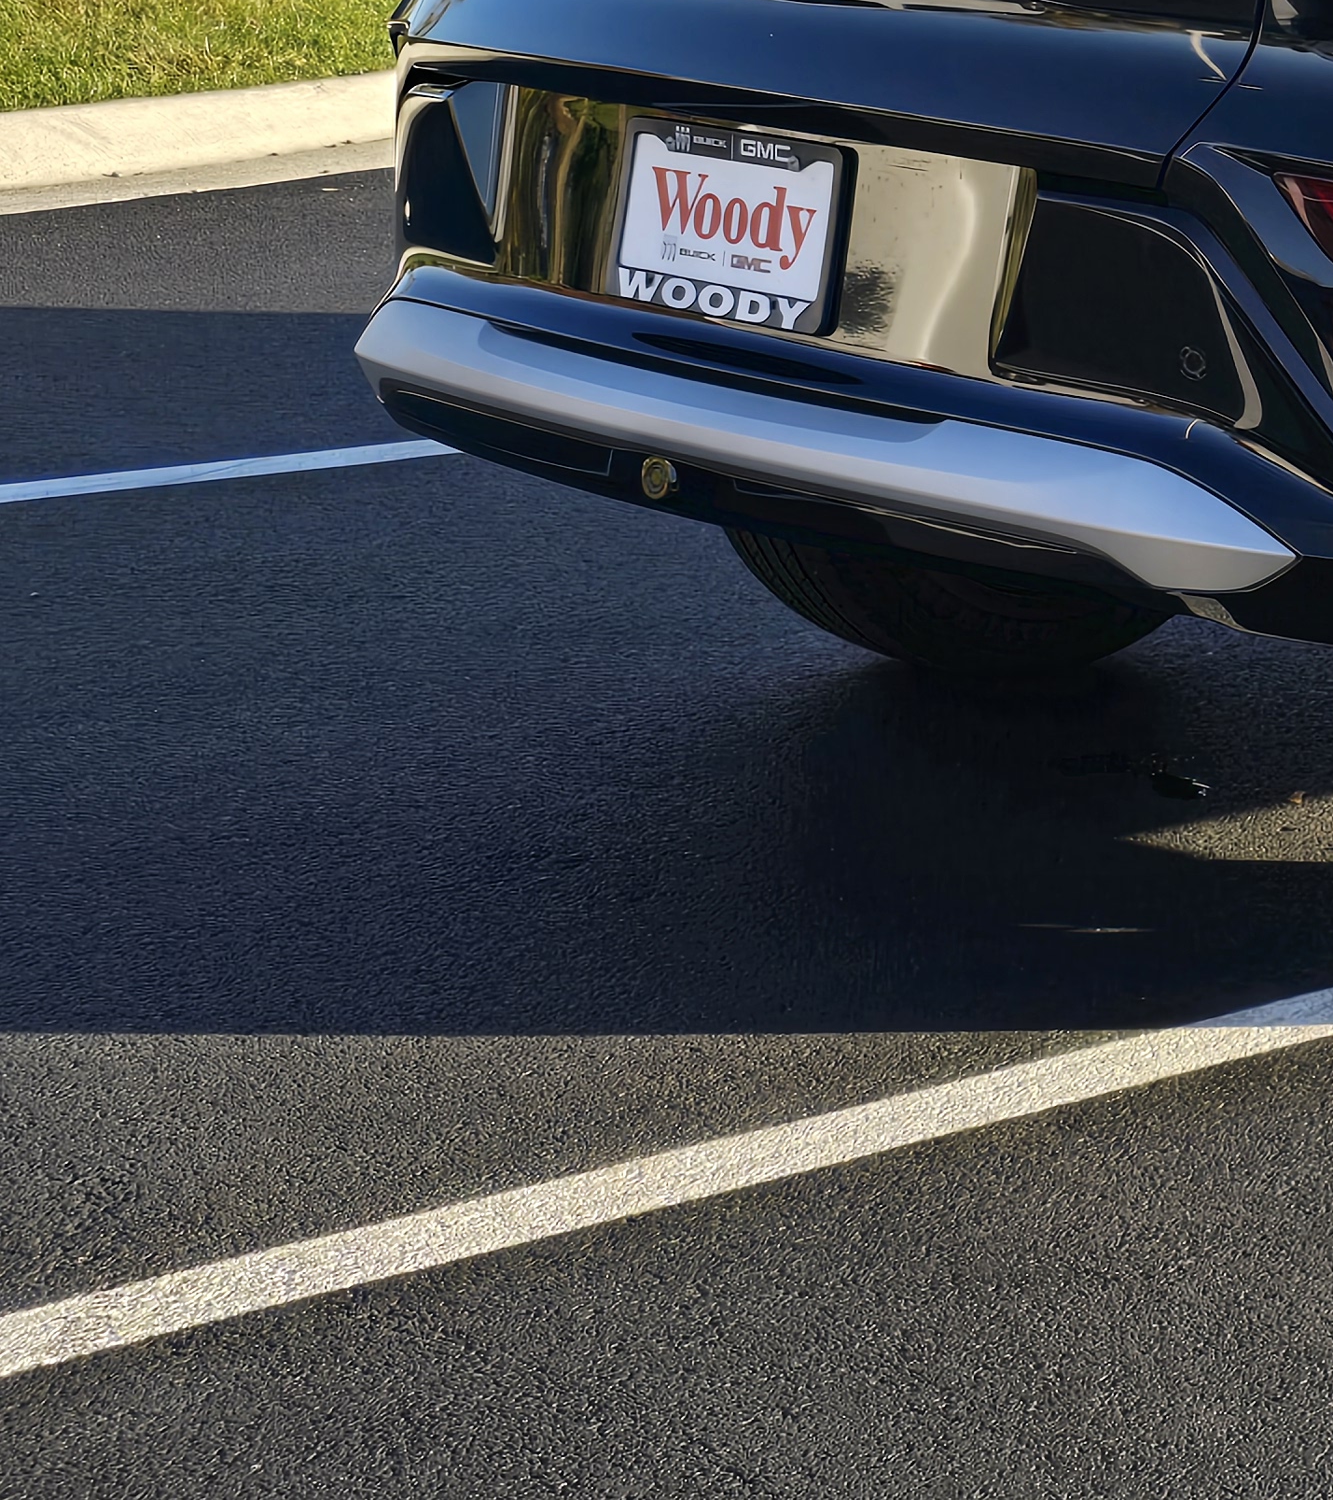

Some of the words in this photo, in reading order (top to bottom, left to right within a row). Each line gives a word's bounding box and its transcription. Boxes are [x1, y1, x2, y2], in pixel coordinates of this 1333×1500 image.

[693, 137, 727, 149] BUICK
[740, 139, 791, 163] GMC
[652, 166, 818, 271] Woody
[679, 247, 716, 262] BUICK
[730, 253, 772, 274] GMC
[618, 266, 811, 331] WOODY
